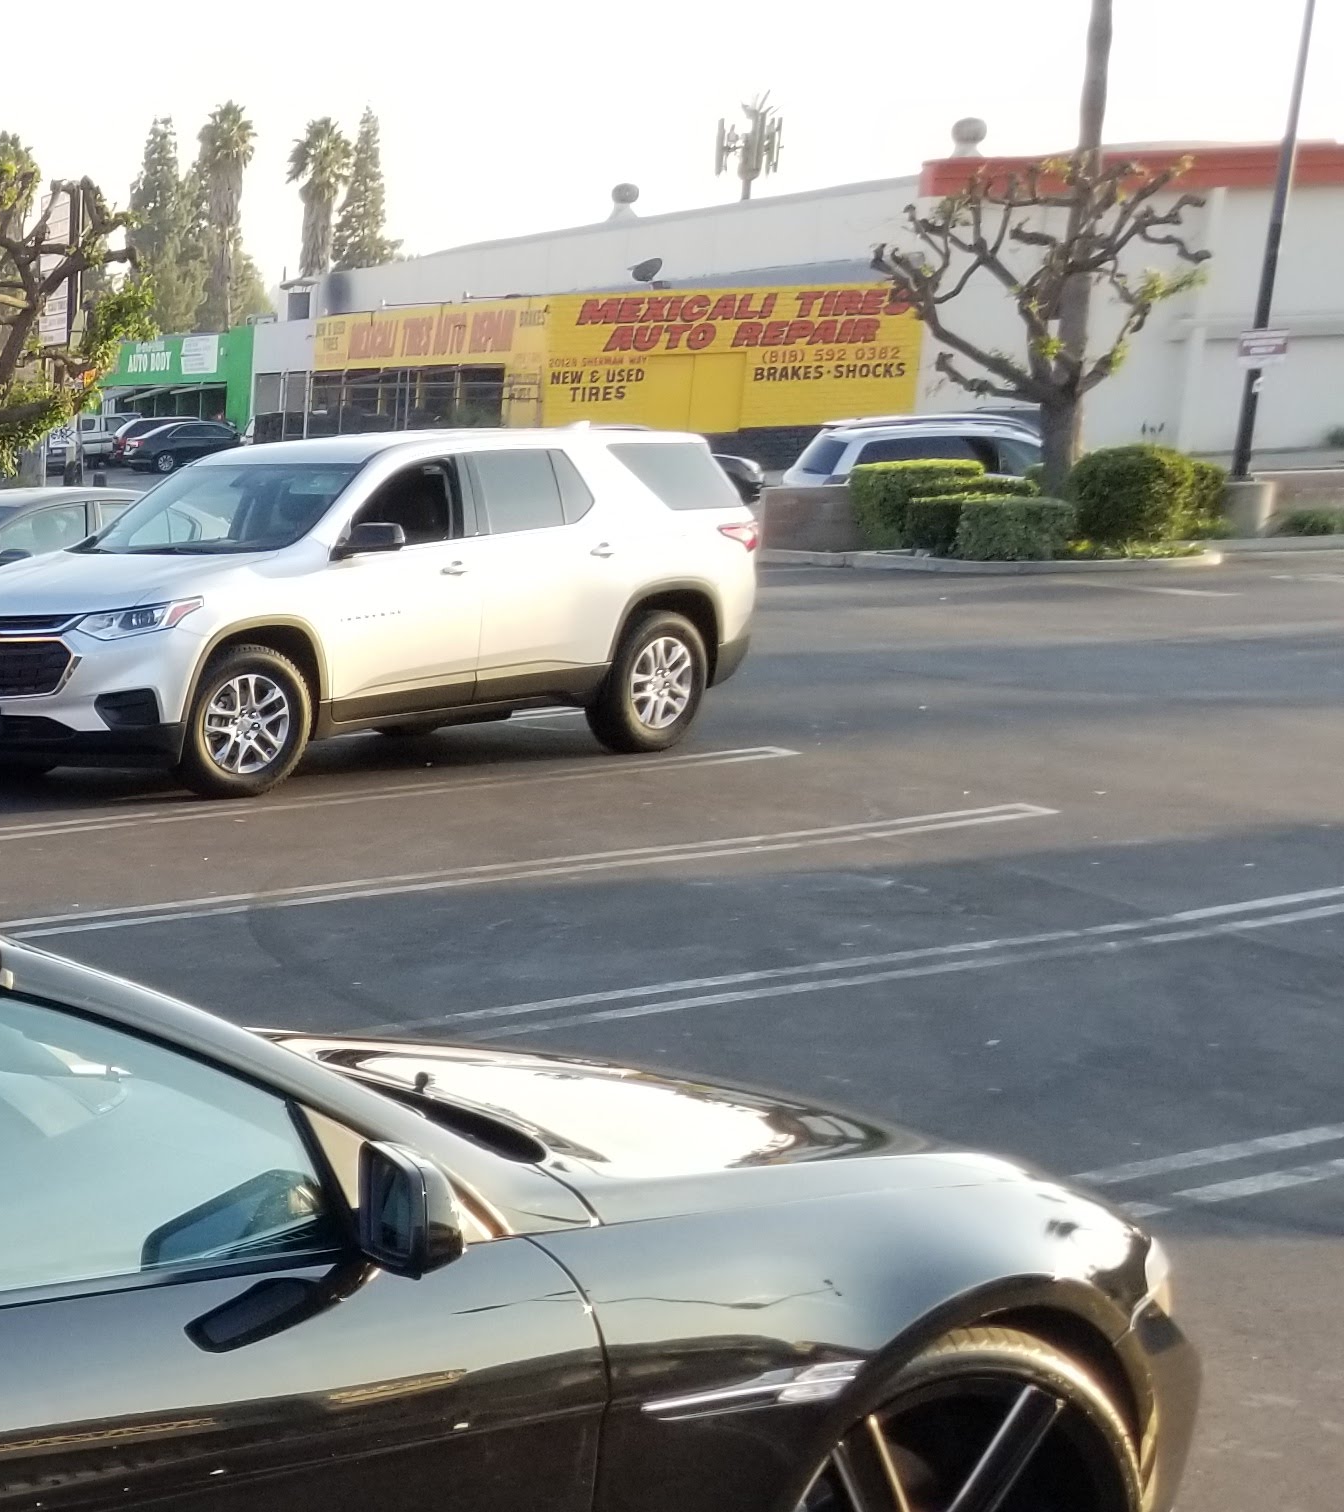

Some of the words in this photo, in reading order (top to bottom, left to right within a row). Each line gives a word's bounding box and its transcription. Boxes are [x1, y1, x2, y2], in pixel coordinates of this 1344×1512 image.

[576, 292, 778, 326] MEXICALI
[795, 288, 912, 318] TIRES
[602, 322, 717, 353] AUTO
[730, 318, 881, 348] REPAIR
[127, 353, 148, 373] AUTO
[150, 351, 172, 371] BODY
[582, 356, 624, 367] SHERMAN
[628, 355, 647, 365] WAY
[762, 351, 805, 364] (818)
[813, 348, 846, 362] 592
[550, 370, 583, 385] NEW
[590, 369, 601, 383] &
[606, 368, 645, 383] USED
[569, 385, 626, 402] TIRES
